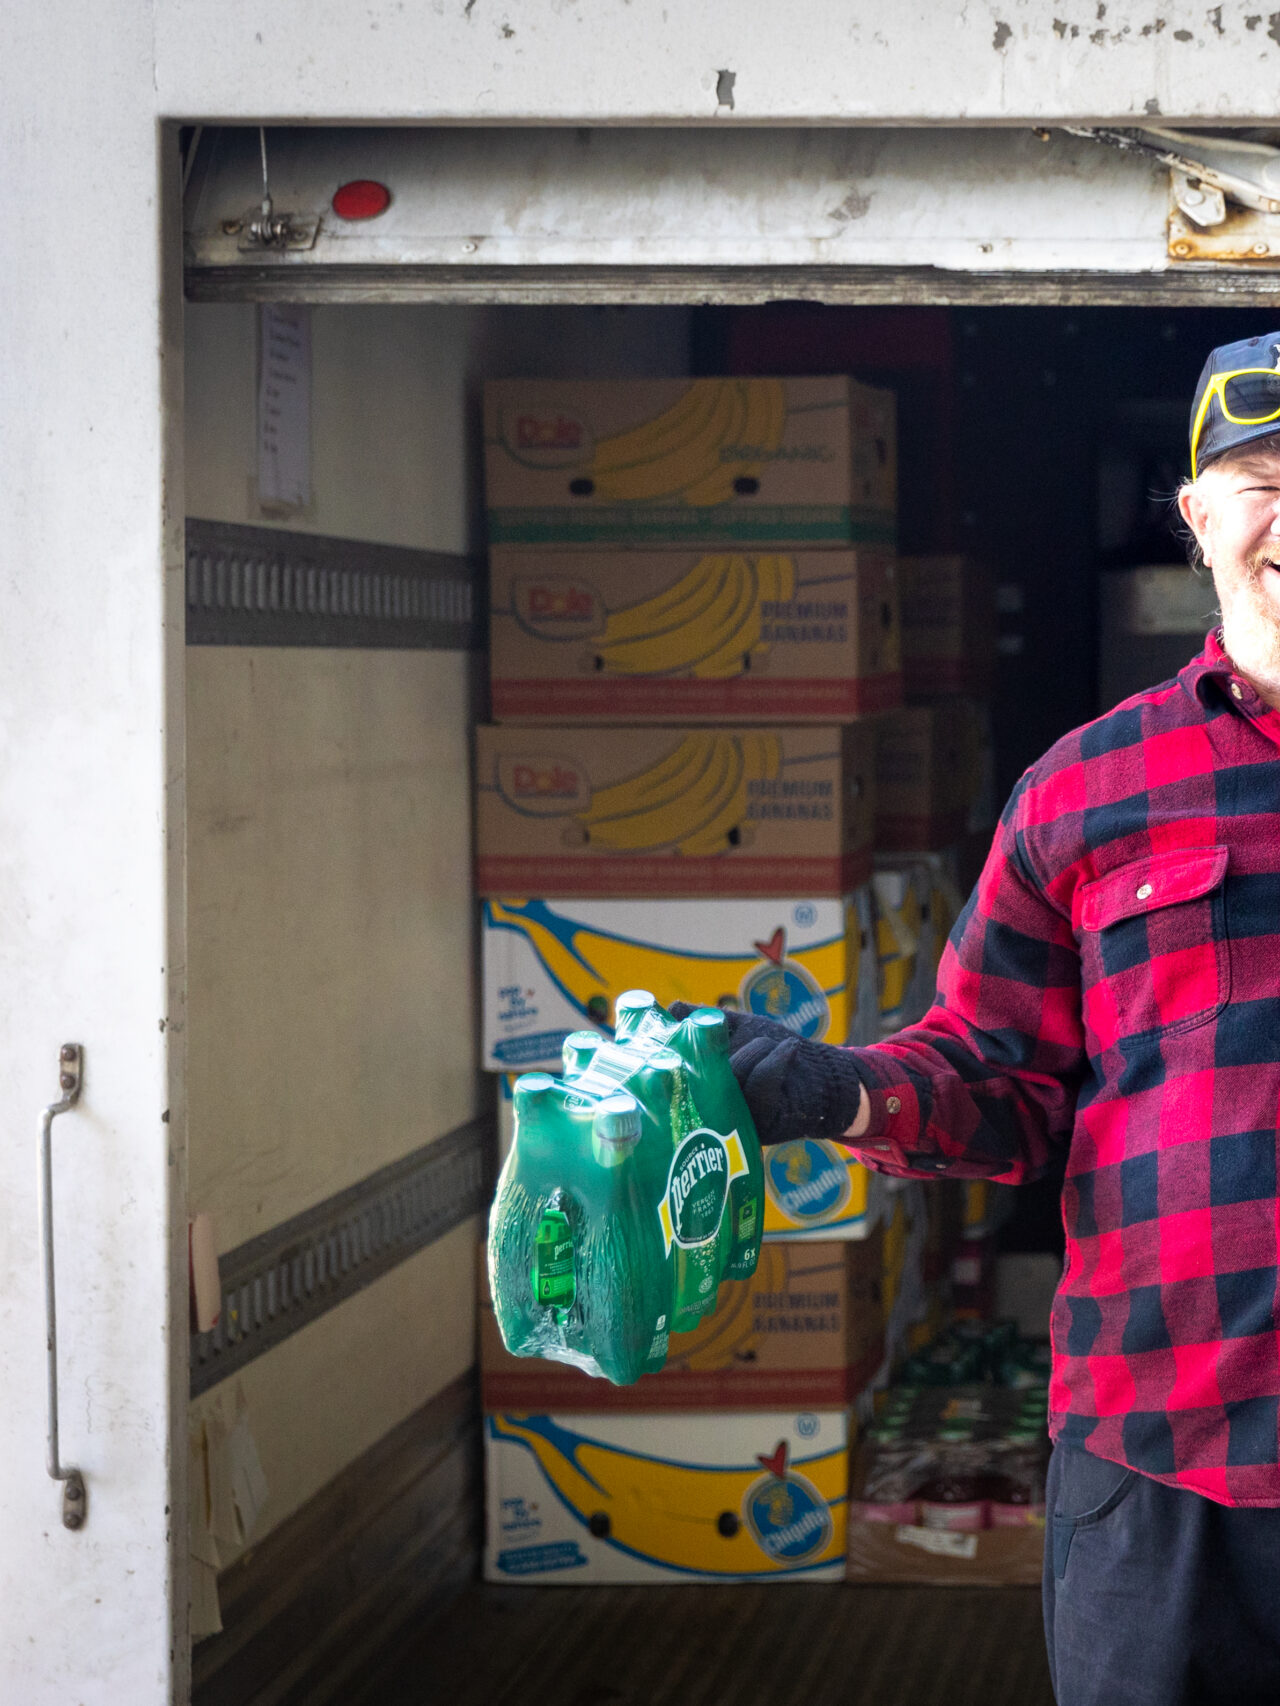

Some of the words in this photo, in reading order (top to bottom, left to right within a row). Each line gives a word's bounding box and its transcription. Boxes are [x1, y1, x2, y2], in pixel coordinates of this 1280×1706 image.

[529, 586, 593, 614] Dole
[513, 765, 579, 792] Dole
[759, 1504, 829, 1555] Chiquita
